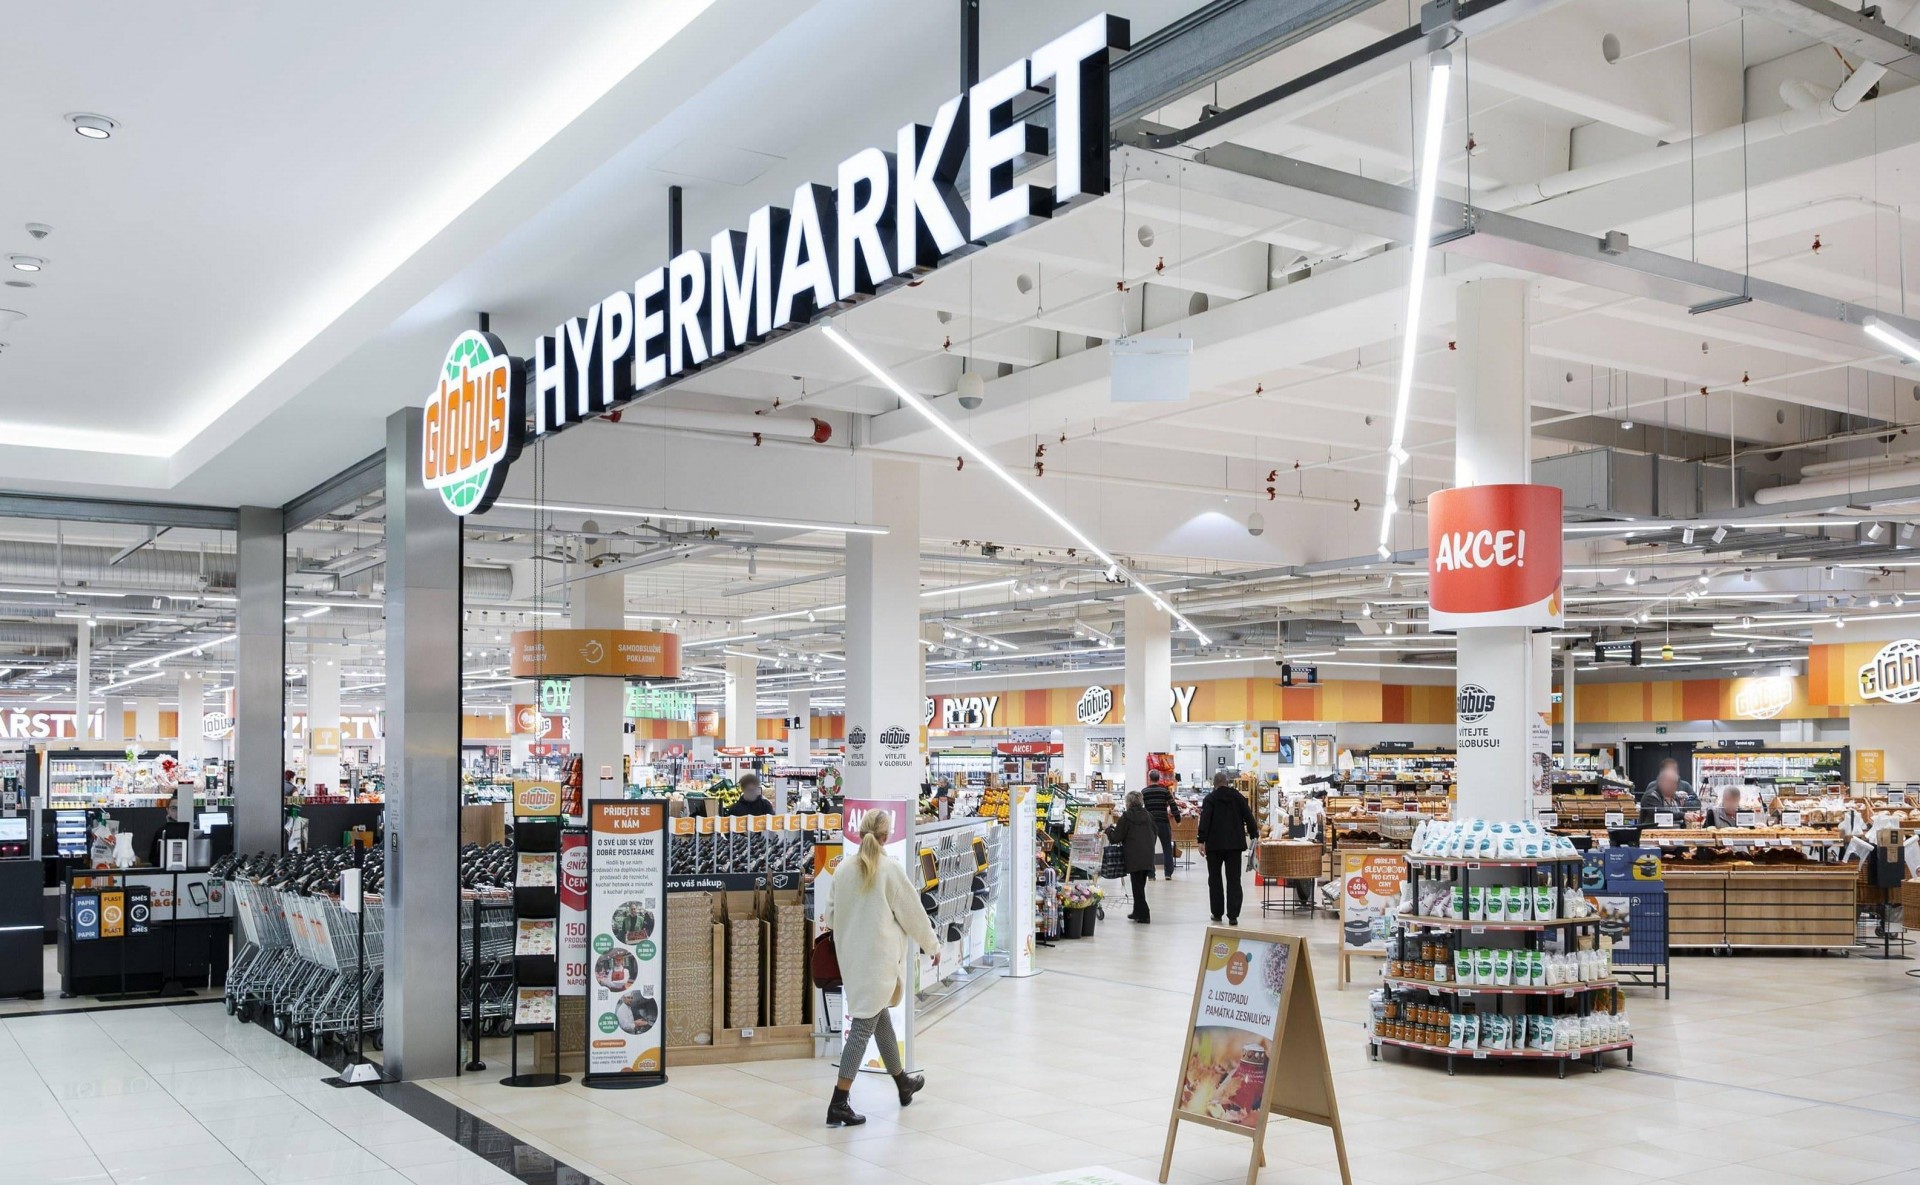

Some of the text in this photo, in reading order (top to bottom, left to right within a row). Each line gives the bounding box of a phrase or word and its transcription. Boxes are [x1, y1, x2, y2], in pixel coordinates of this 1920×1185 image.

[535, 12, 1108, 435] HYPERMARKET
[1436, 529, 1525, 573] AKCE!
[943, 696, 999, 729] RYBY
[1459, 726, 1489, 736] VÍTEJTE
[1012, 744, 1032, 753] AKCE!
[5, 793, 15, 801] 73
[603, 806, 651, 818] PŘIDEJTE SE
[614, 818, 640, 829] K NÁM
[604, 838, 615, 846] SVÉ
[638, 838, 654, 846] VŽDY
[596, 848, 655, 856] DOBŘE POSTARÁME
[566, 859, 587, 871] SNÍŽ
[681, 879, 695, 888] váš
[697, 879, 722, 889] nákup
[77, 898, 96, 907] PAPÍR
[131, 894, 148, 902] SMĚS
[1208, 989, 1249, 1006] 2. LISTOPADU
[1205, 1004, 1271, 1026] PAMÁTKA ZESNULÝCH
